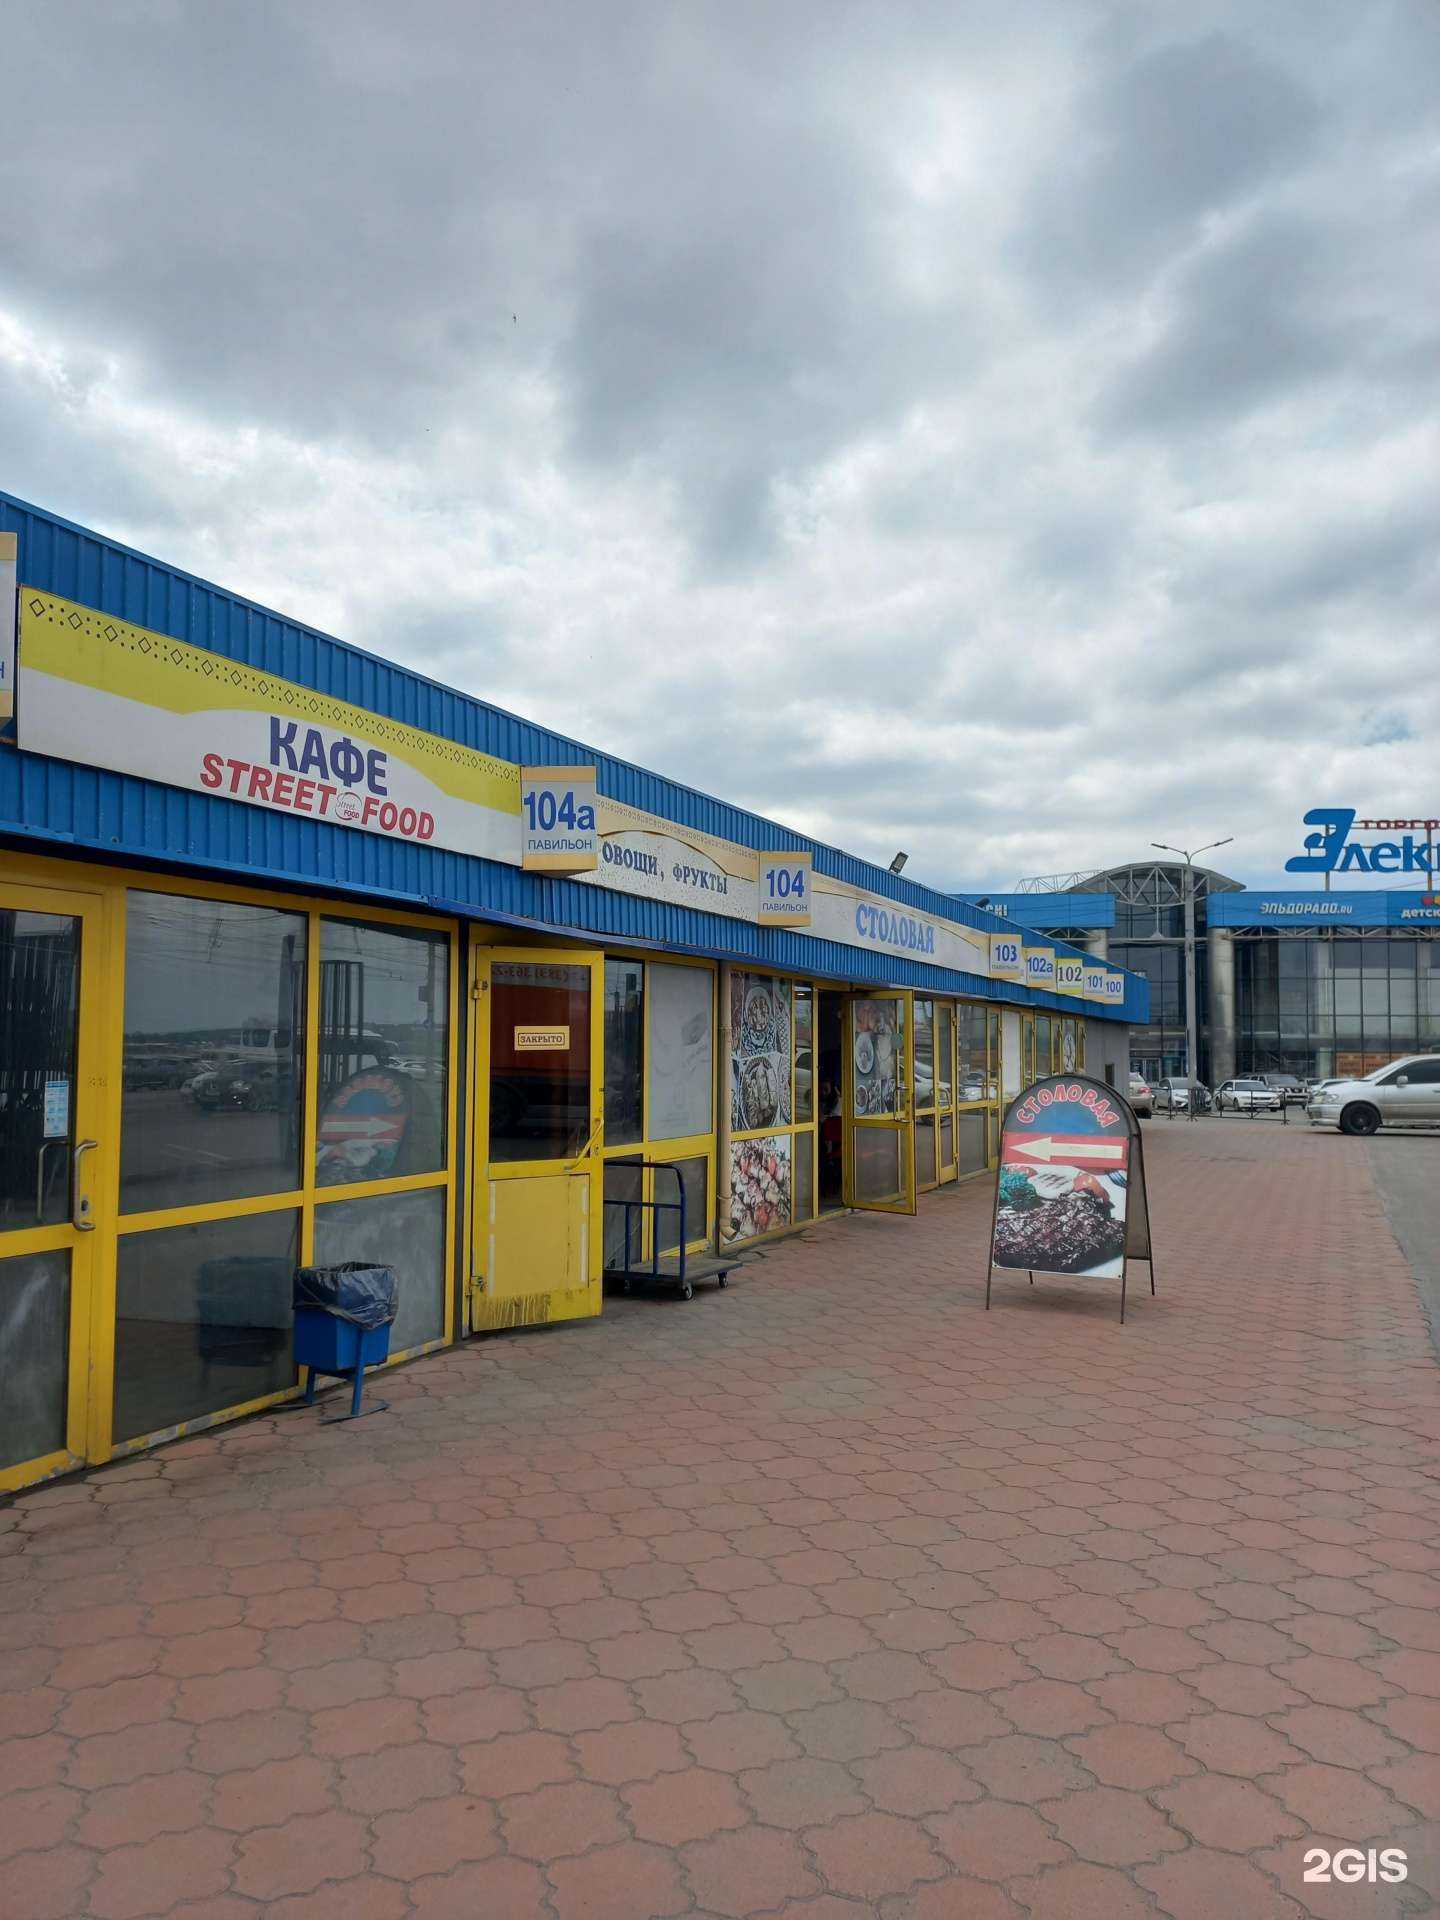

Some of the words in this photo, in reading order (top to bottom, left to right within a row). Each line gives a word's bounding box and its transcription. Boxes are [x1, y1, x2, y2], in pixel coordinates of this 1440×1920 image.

[270, 716, 388, 796] КАФЕ
[200, 753, 337, 815] STREET
[361, 796, 435, 840] FOOD
[1360, 819, 1440, 830] ТОРГО
[528, 838, 592, 850] ПАВИЛЬОН
[1285, 809, 1440, 873] Элек
[766, 869, 805, 898] 104
[762, 902, 808, 912] ПАВИЛЬОН
[856, 903, 935, 954] СТОЛОВАЯ
[995, 944, 1018, 962] 103
[1057, 966, 1082, 982] 102
[1088, 975, 1103, 988] 101
[1106, 981, 1122, 993] 100
[520, 1035, 563, 1044] ЗАКРЫТО
[1017, 1084, 1120, 1128] СТОЛОВАЯ
